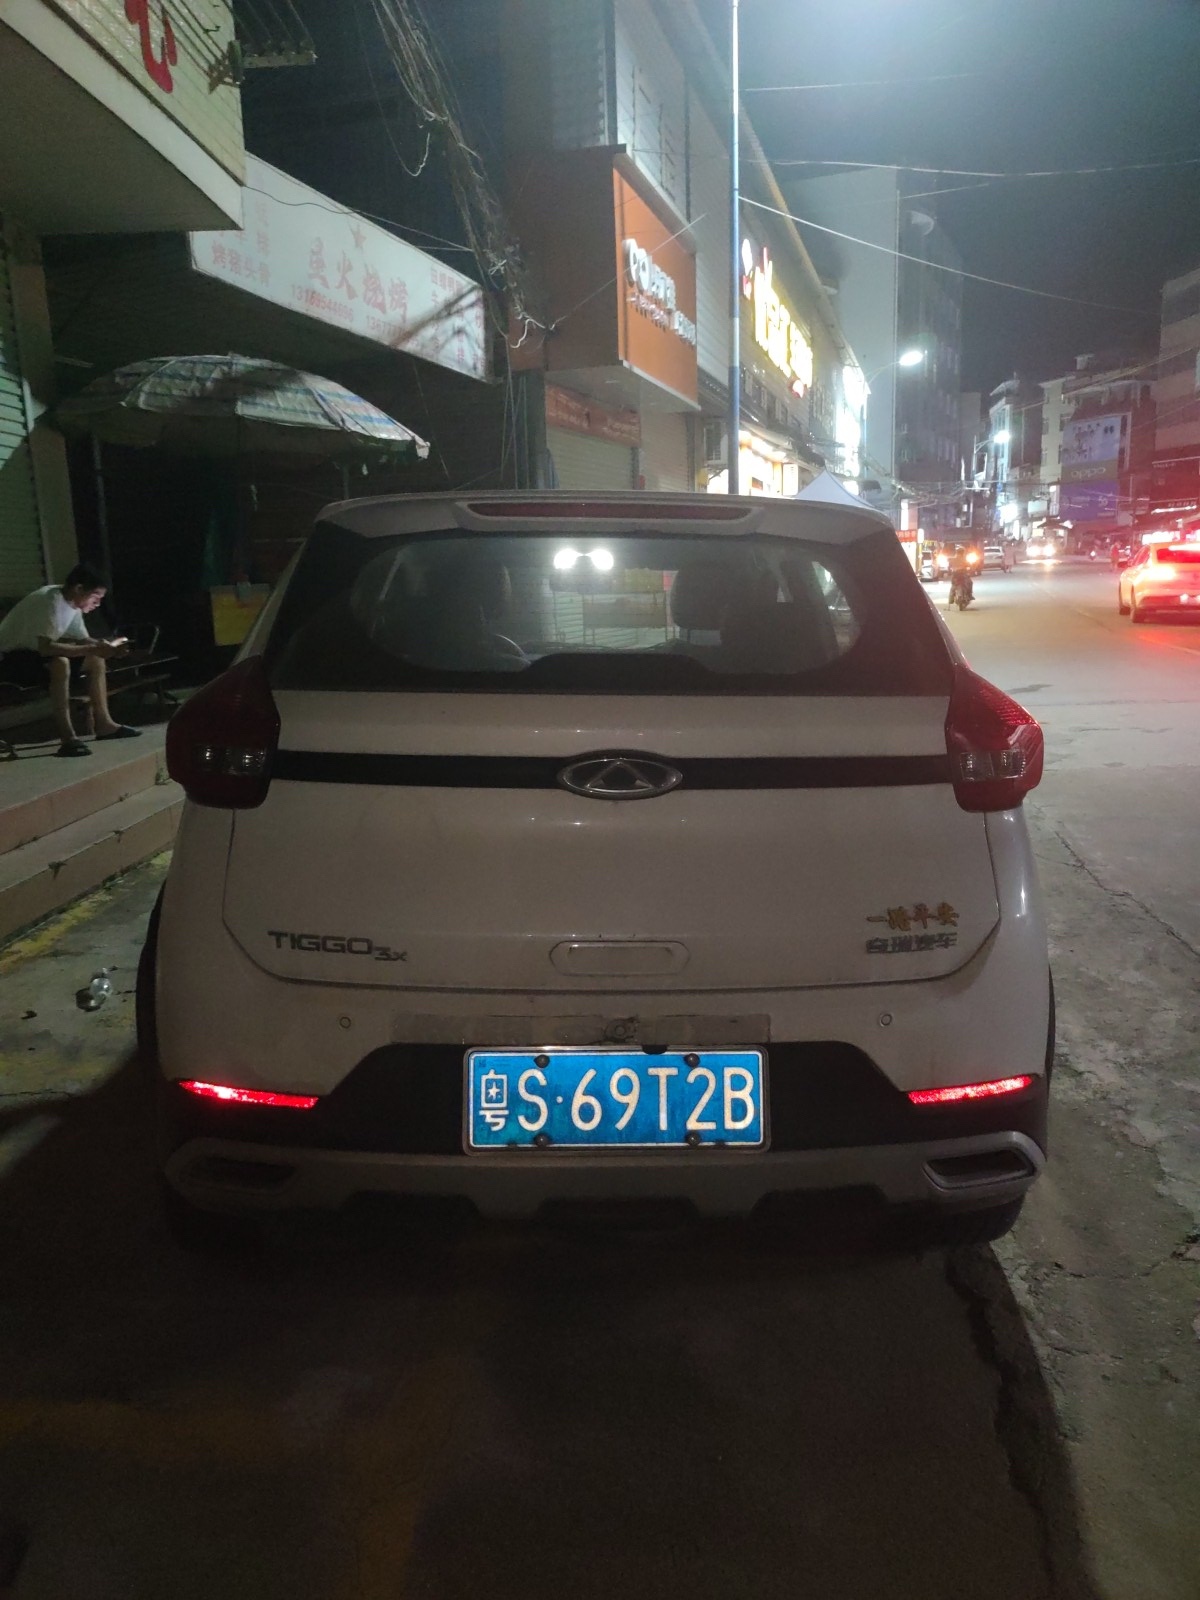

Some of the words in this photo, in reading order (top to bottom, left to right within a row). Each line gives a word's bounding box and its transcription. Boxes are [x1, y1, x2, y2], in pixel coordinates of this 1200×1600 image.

[267, 930, 373, 955] TIGGO
[865, 932, 958, 955] 奇瑞汽车
